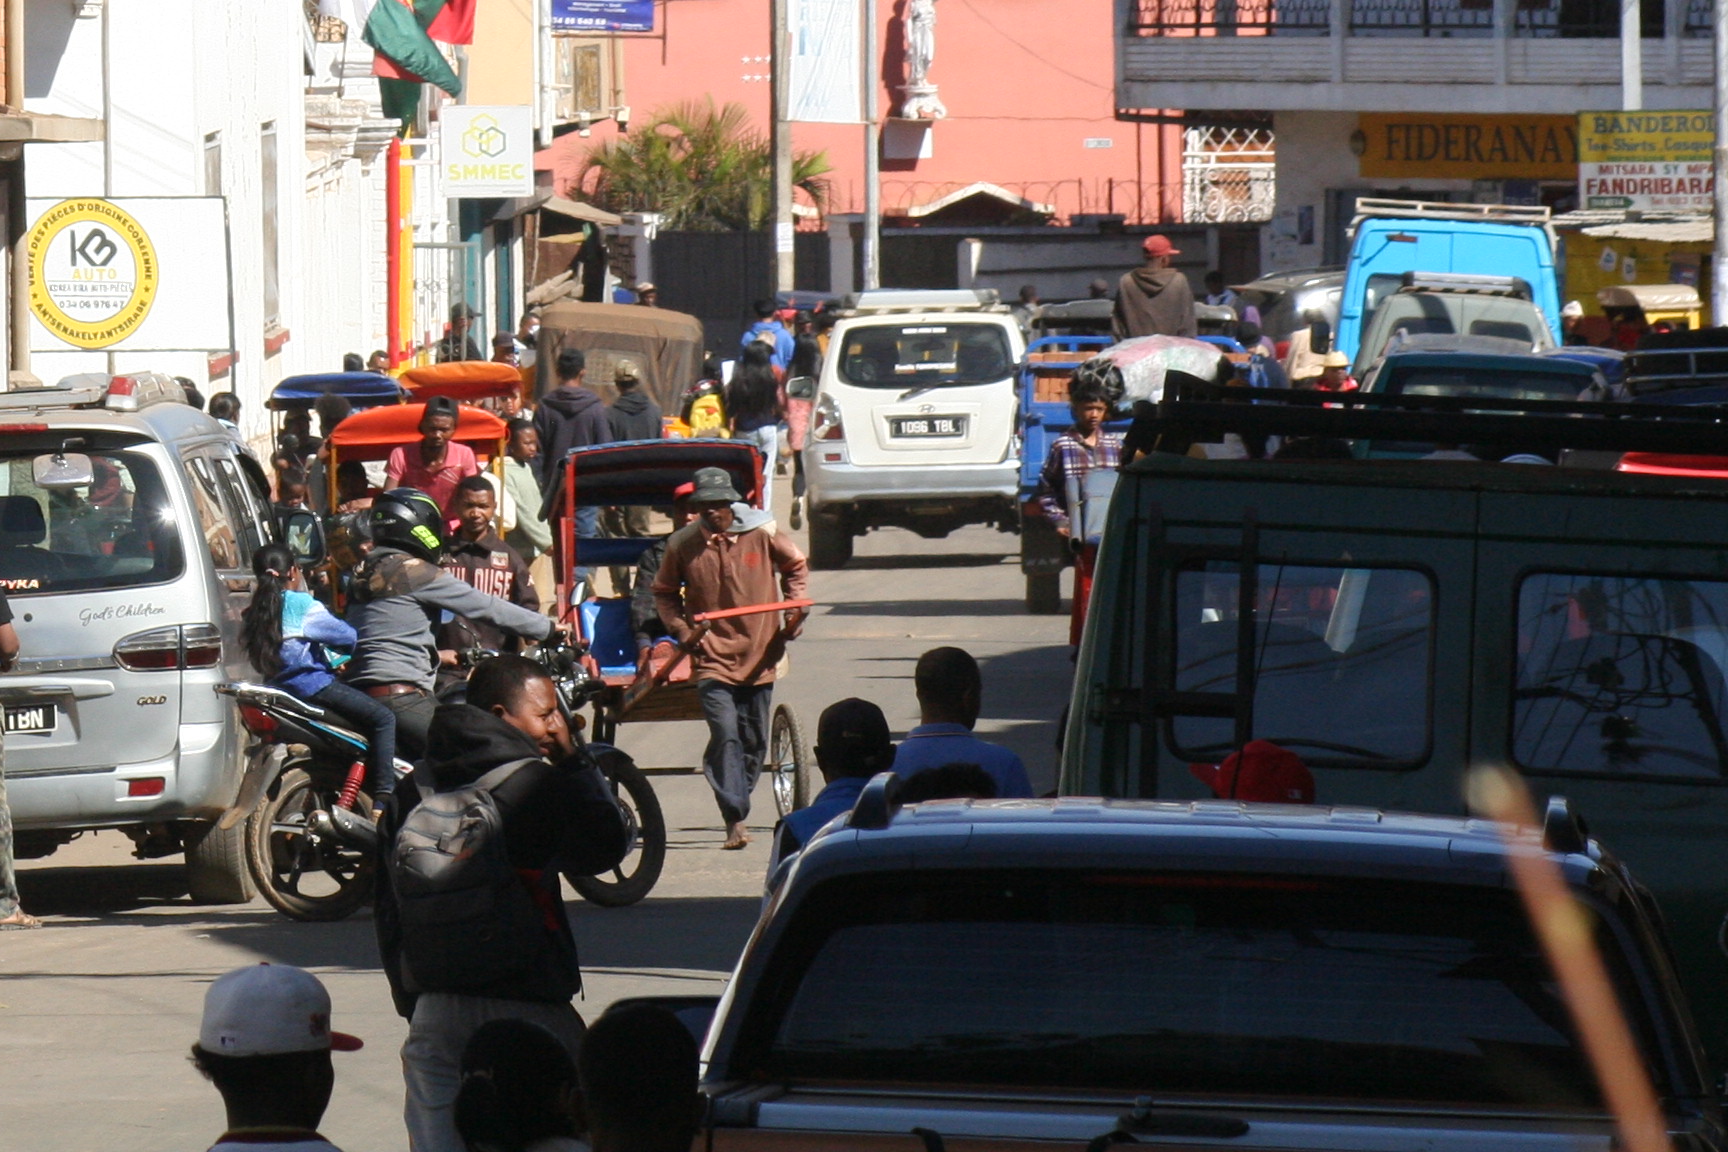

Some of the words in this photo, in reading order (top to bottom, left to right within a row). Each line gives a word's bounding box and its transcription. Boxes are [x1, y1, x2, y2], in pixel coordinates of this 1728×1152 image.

[448, 164, 526, 180] SMMEC
[1598, 164, 1655, 175] MITSARA
[1663, 164, 1679, 175] SY
[31, 228, 45, 249] DES
[77, 202, 128, 227] D'ORIGINE
[72, 268, 117, 281] AUTO
[79, 606, 113, 626] God's
[115, 603, 166, 618] Children
[137, 695, 167, 707] GOLD
